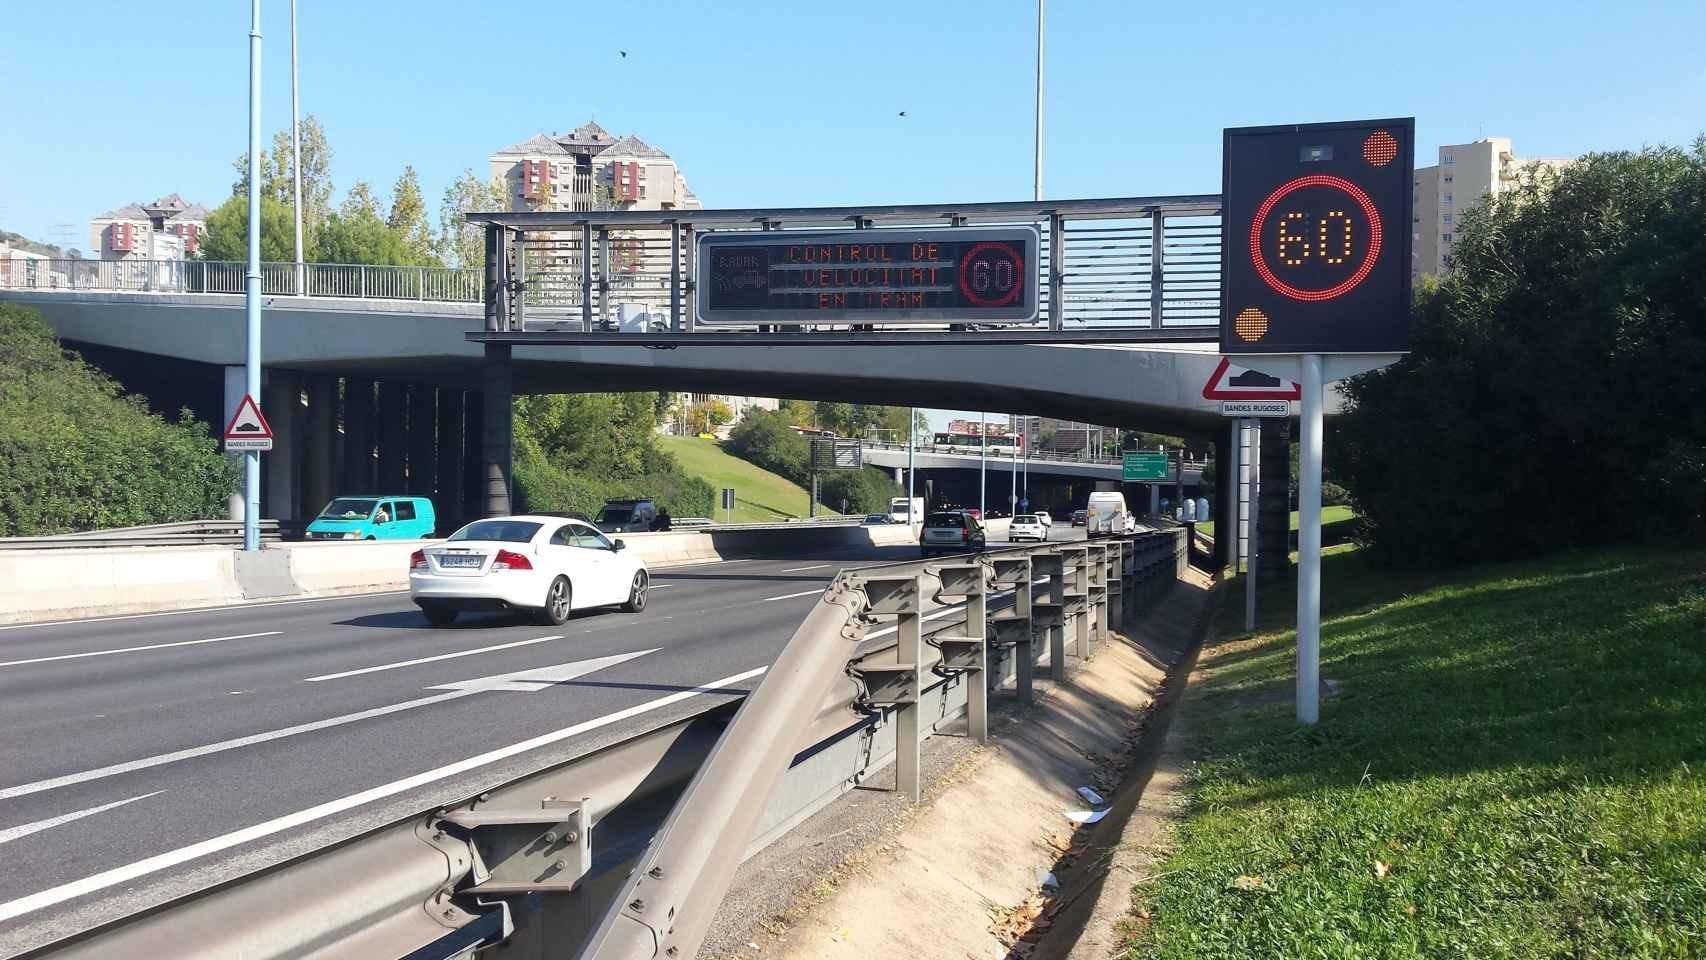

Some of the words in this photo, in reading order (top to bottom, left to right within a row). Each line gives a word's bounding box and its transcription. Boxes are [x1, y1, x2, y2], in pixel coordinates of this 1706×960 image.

[1279, 210, 1352, 265] 60
[786, 246, 893, 262] CONTROL
[911, 244, 939, 261] DE
[803, 267, 938, 286] VELOCITAT
[972, 259, 1014, 291] 60
[818, 293, 846, 309] EN
[868, 292, 923, 309] TRAM
[1224, 404, 1252, 412] BANDES
[1253, 404, 1286, 412] RUGOSES
